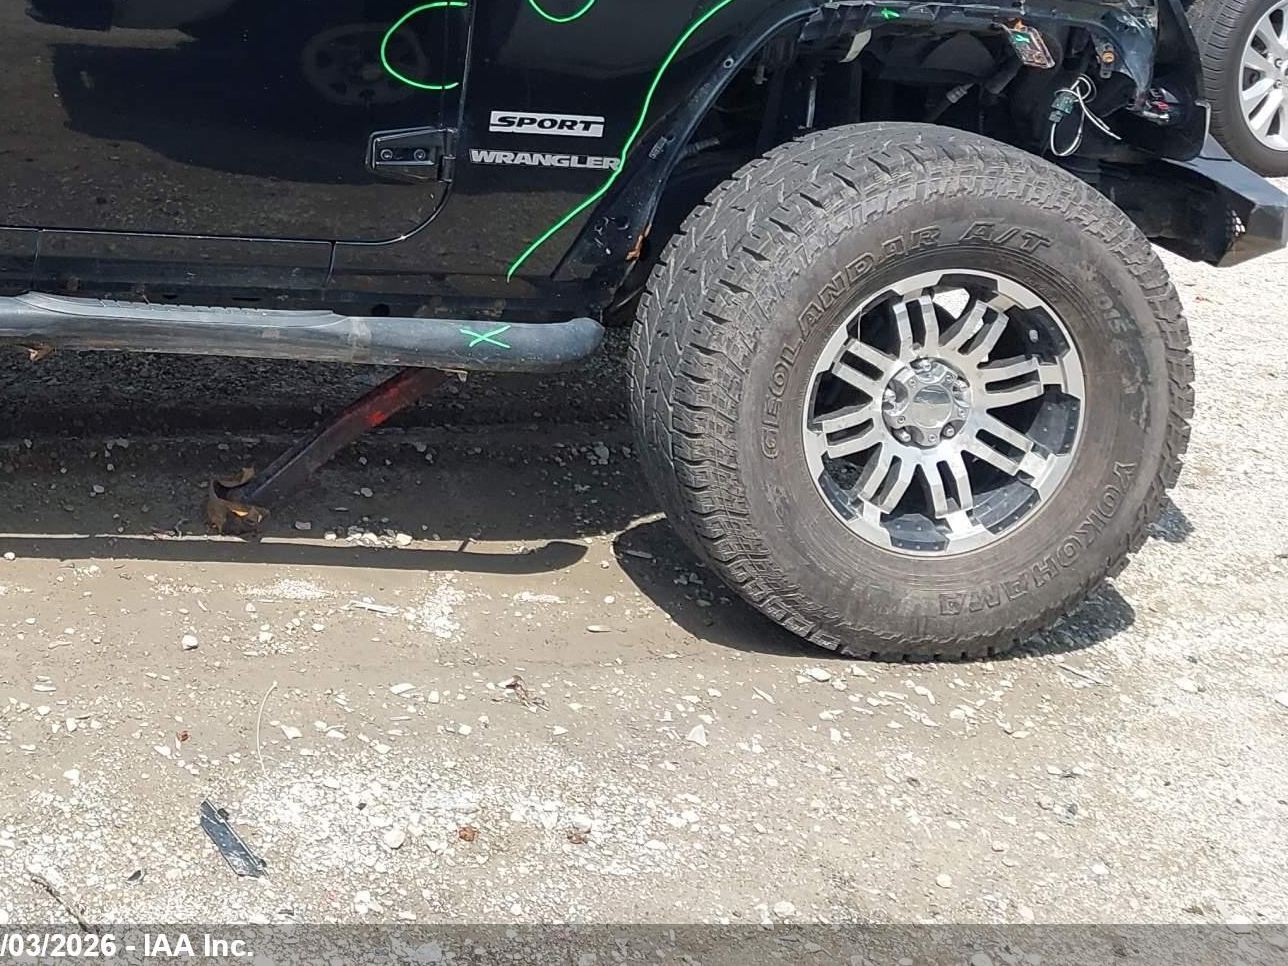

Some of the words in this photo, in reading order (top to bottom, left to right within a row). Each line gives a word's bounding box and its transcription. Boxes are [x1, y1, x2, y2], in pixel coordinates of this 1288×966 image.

[469, 148, 621, 171] WRANGLER
[496, 115, 604, 132] SPORT
[762, 225, 941, 460] GEOLANDAR
[958, 220, 1052, 253] A/T
[939, 461, 1137, 617] YOKOHAMA
